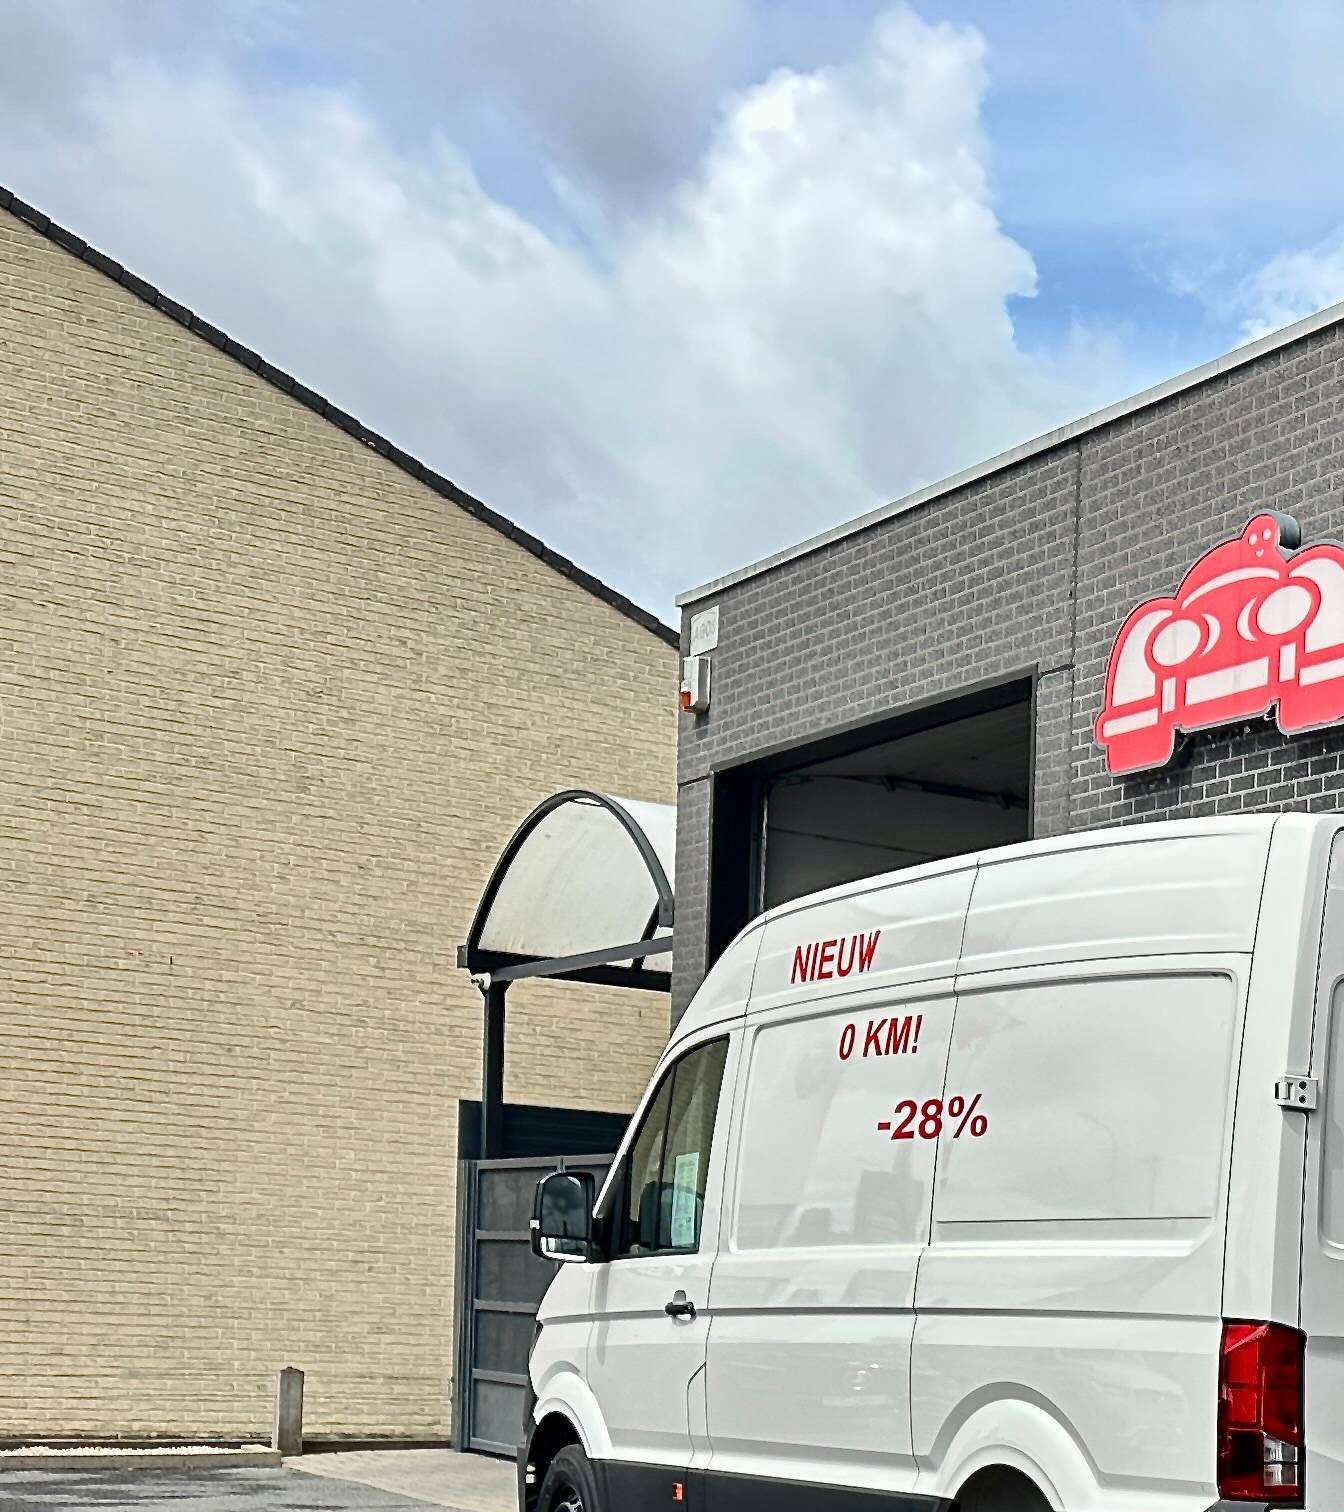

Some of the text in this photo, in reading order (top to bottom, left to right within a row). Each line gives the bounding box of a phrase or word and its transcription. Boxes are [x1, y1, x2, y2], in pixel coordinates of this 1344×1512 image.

[790, 930, 881, 984] NIEUW
[839, 1015, 923, 1060] 0 KM!
[877, 1094, 988, 1141] -28%
